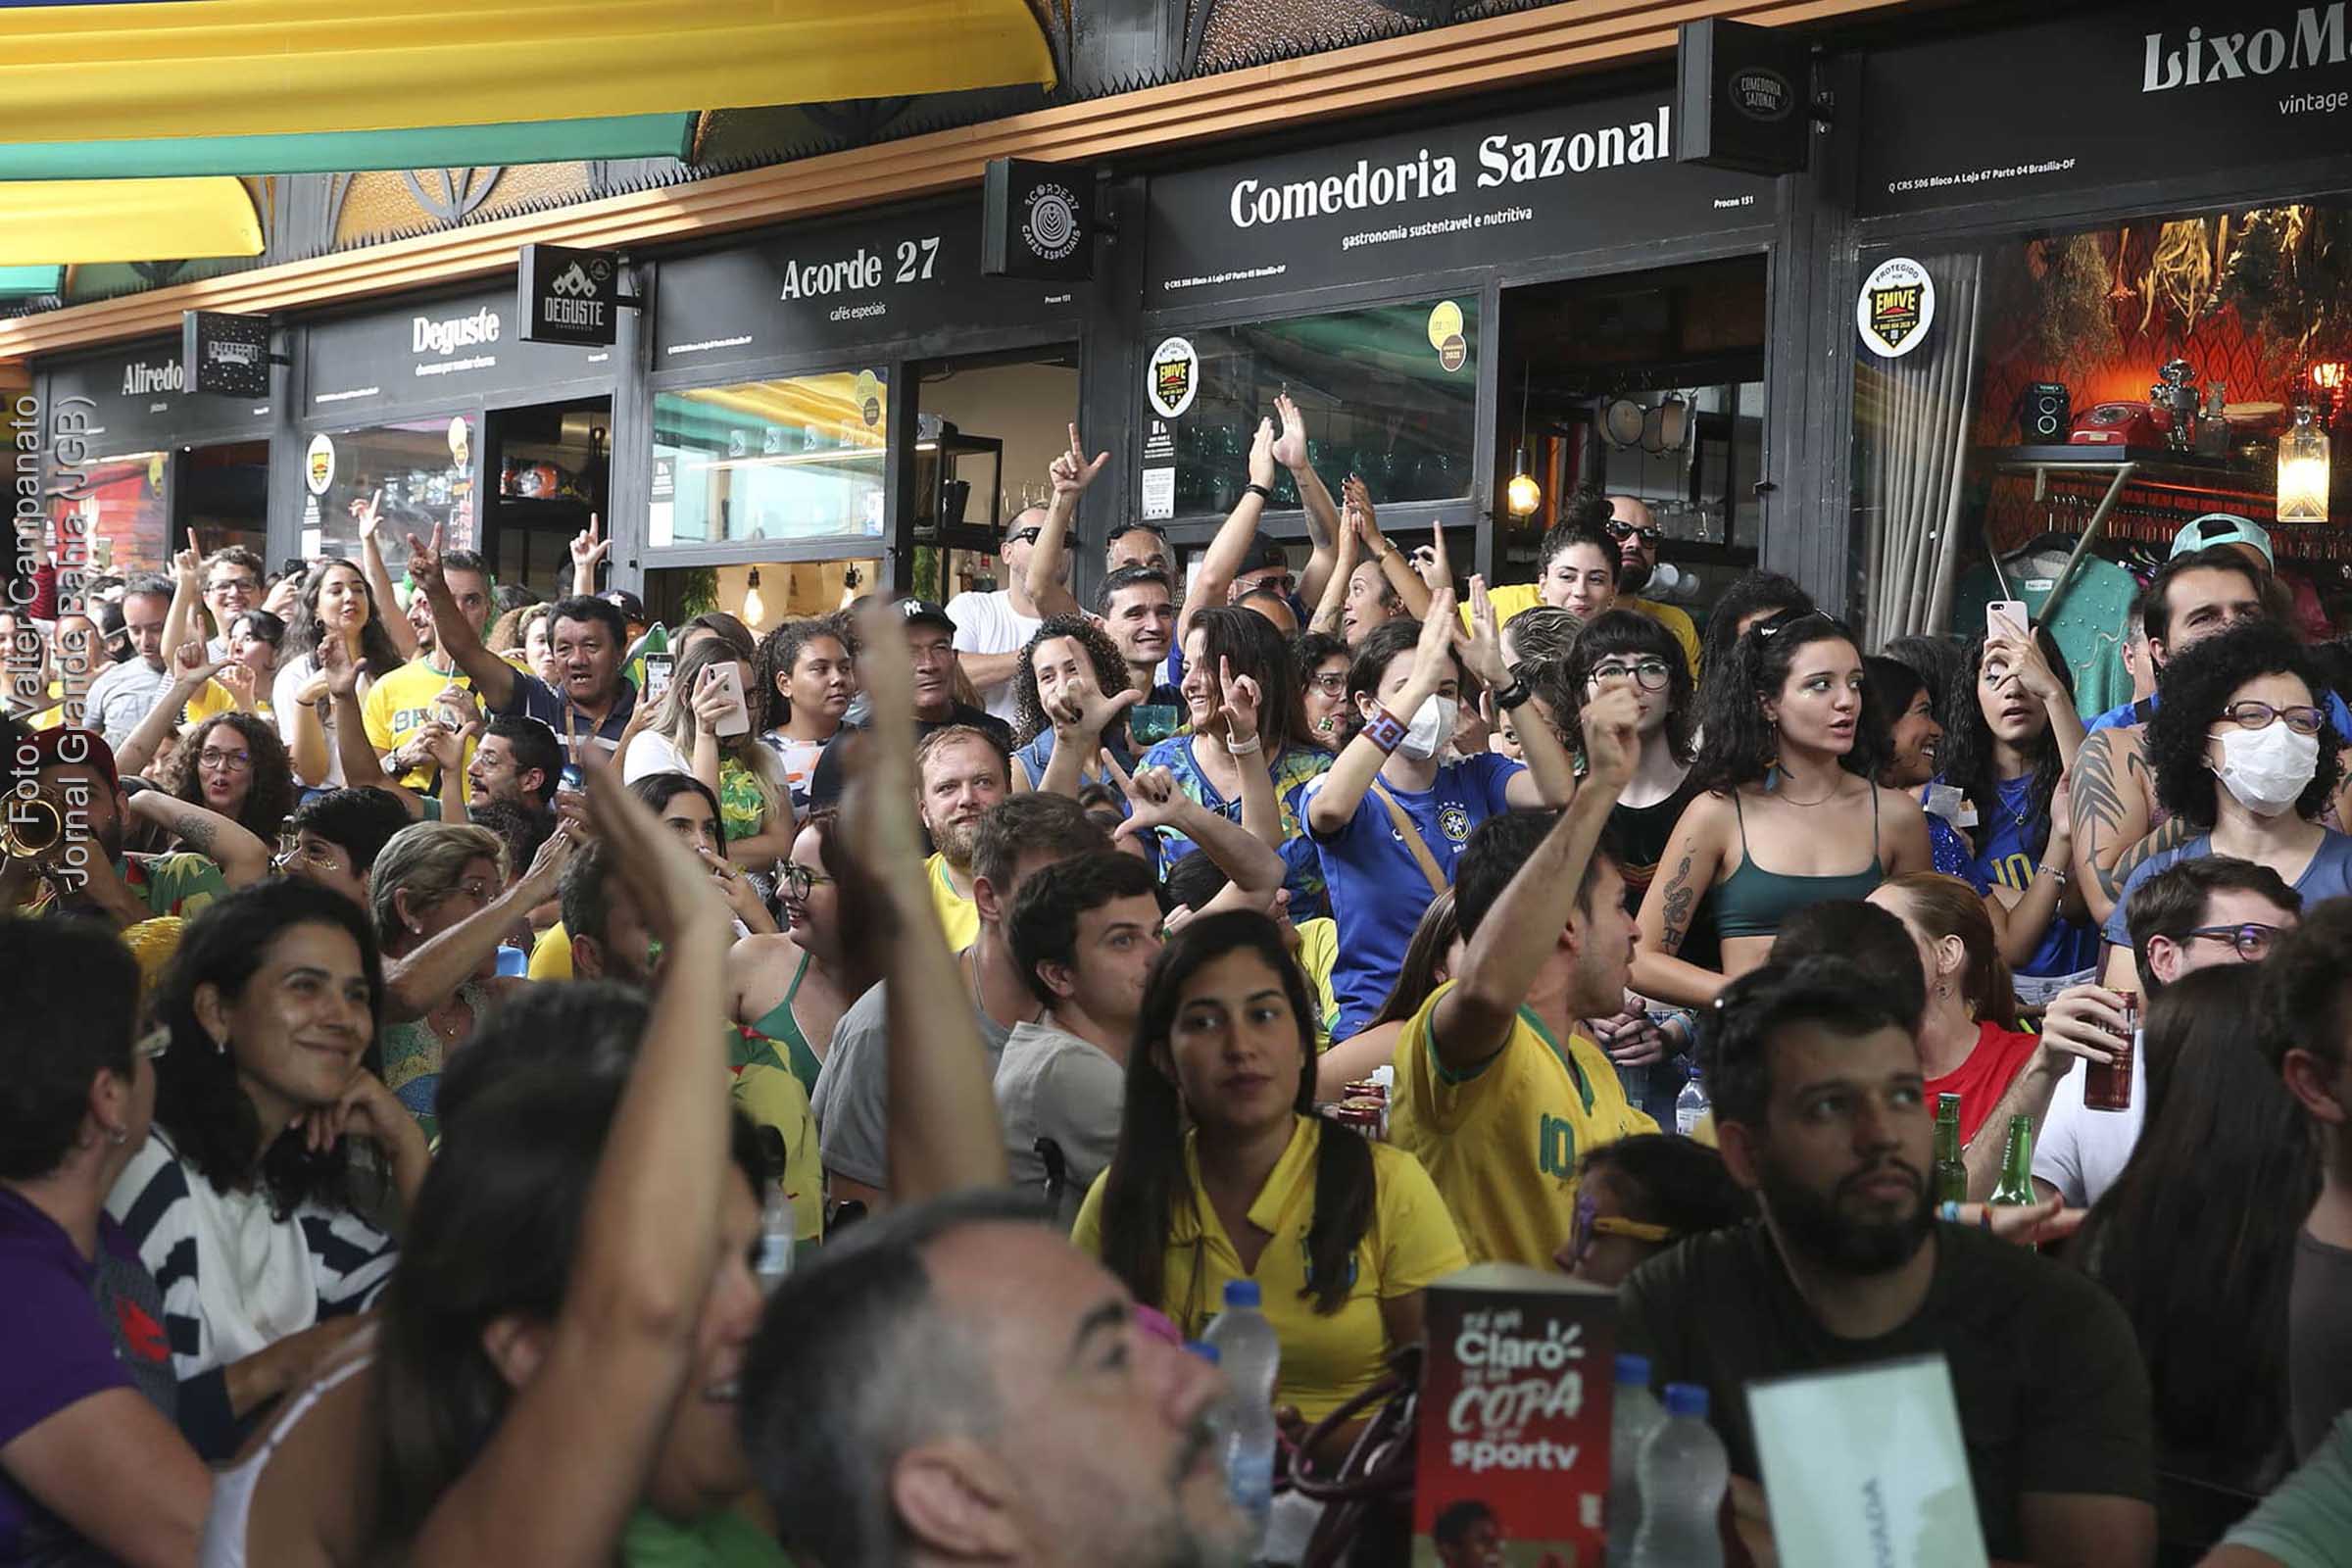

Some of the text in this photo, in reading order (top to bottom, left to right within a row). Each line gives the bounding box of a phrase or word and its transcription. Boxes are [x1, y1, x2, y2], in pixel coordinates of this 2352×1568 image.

[2142, 2, 2352, 92] LixoM
[2278, 92, 2348, 115] vintage
[1230, 106, 1671, 227] Comedoria Sazonal
[1930, 175, 1953, 187] Bloco
[1954, 173, 1961, 183] A
[1962, 172, 1979, 184] Loja
[1981, 170, 1991, 180] 67
[1992, 168, 2015, 179] Parte
[2016, 166, 2028, 175] 04
[1343, 207, 1533, 250] gastronomia sustentavel e nutritiva
[780, 237, 940, 300] Acorde 27
[1875, 264, 1919, 282] PROTEGIDO
[545, 297, 604, 326] DEGUSTE
[852, 302, 886, 320] especiais
[1876, 288, 1916, 315] EMIVE
[413, 306, 499, 355] Deguste
[122, 359, 183, 396] Alfredo
[1991, 853, 2034, 891] 10
[1540, 1112, 1575, 1179] 10
[1455, 1331, 1566, 1370] Claro
[1448, 1369, 1584, 1434] COPA
[1450, 1437, 1580, 1472] sportv
